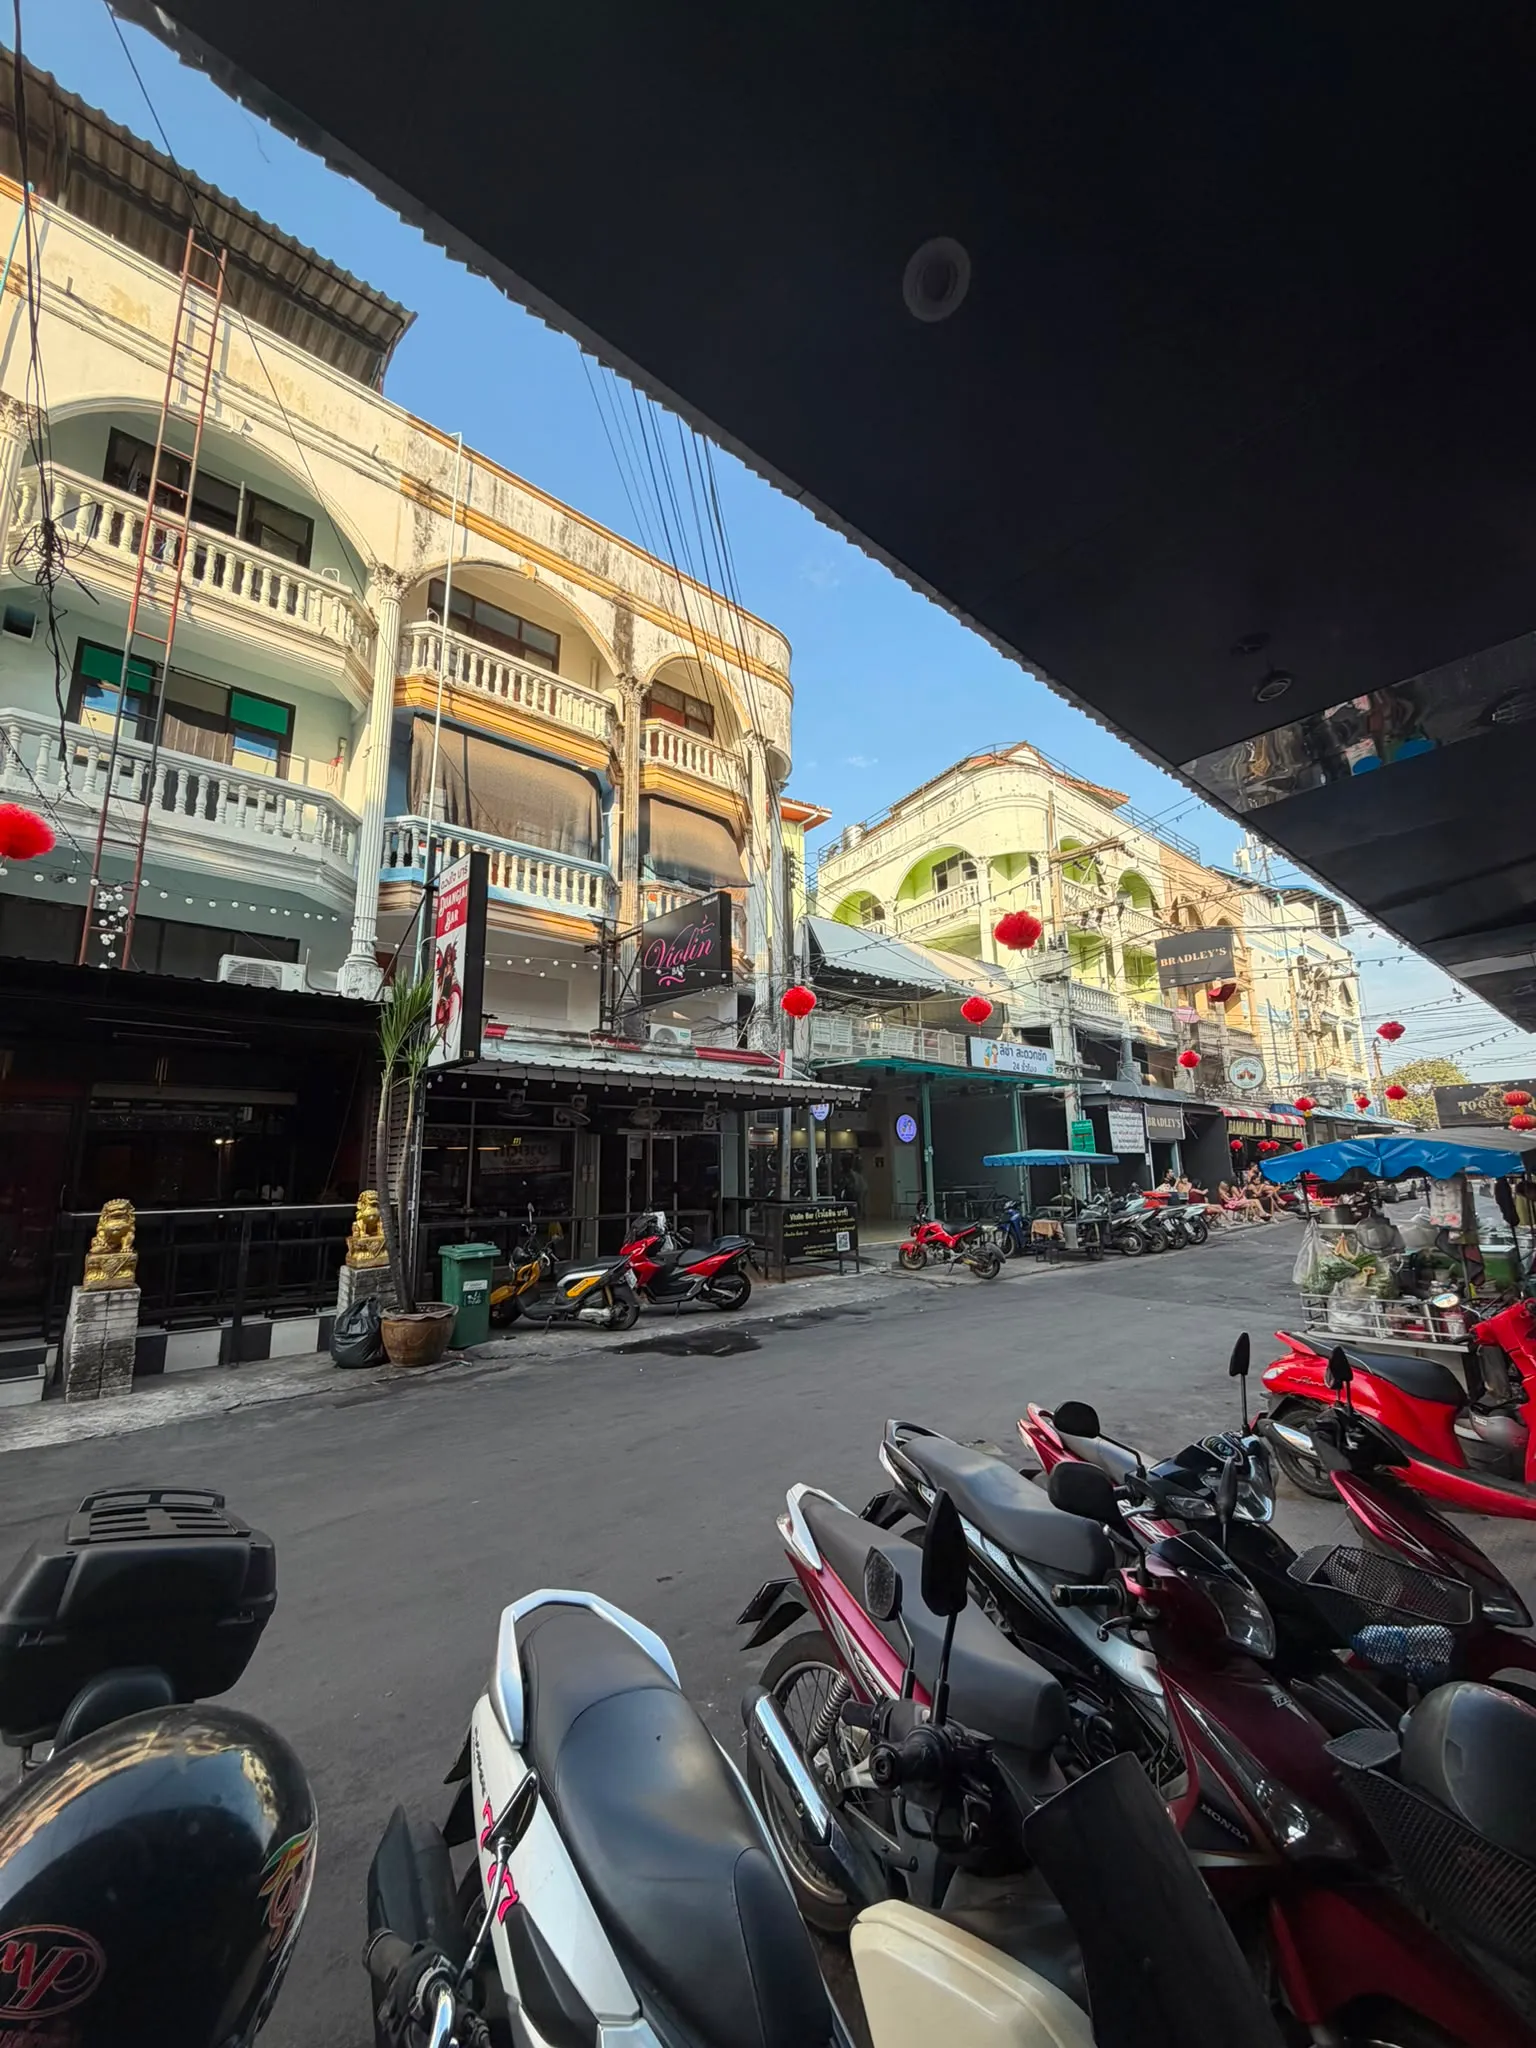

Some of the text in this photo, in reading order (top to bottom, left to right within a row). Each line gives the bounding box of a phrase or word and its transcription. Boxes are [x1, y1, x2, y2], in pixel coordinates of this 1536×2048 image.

[444, 908, 459, 932] BAR
[643, 923, 715, 972] Violin
[1160, 947, 1227, 967] BRADLEY'S
[1012, 1061, 1020, 1071] 24
[1147, 1116, 1181, 1129] BRADLEY'S
[1200, 1803, 1250, 1845] HONDA
